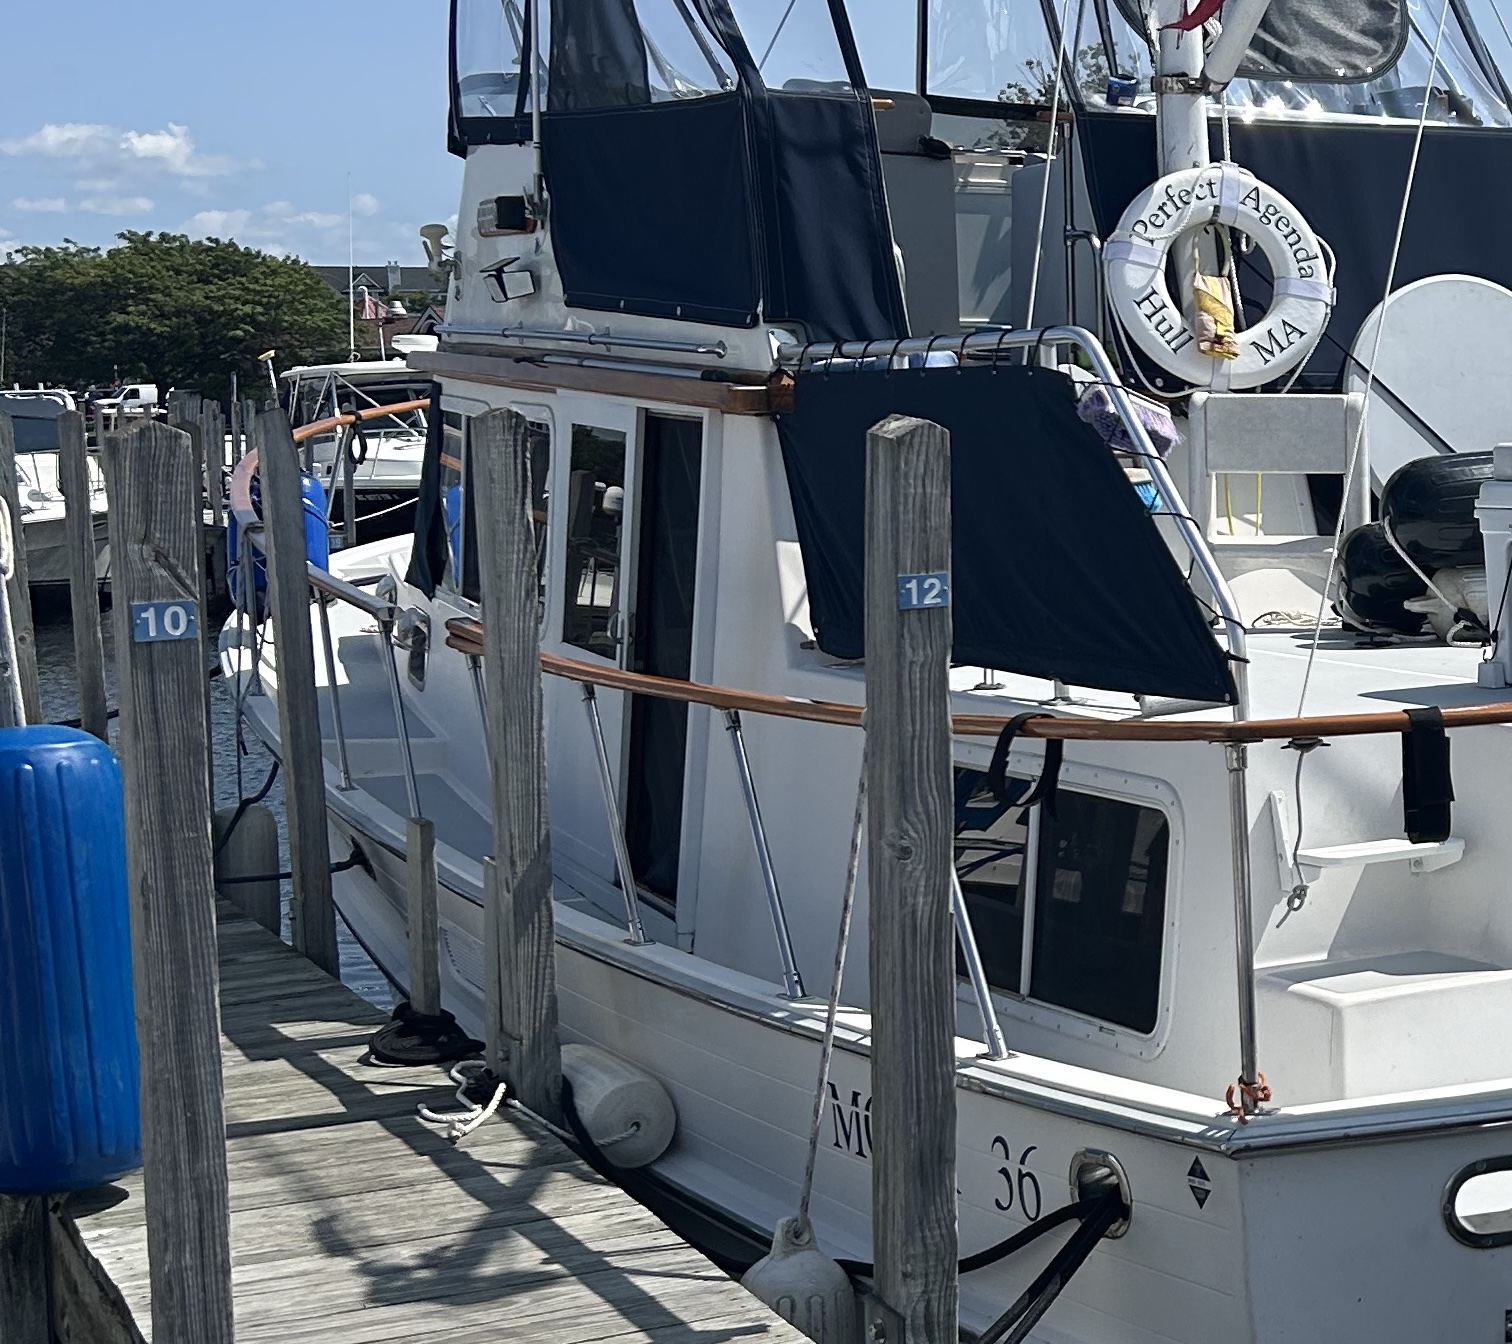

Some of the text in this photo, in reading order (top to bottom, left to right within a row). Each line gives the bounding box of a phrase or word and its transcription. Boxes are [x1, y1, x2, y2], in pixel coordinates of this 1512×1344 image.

[1130, 178, 1319, 279] Perfect Agenda
[1134, 286, 1307, 365] Hull MA
[141, 605, 187, 636] 10
[906, 578, 942, 604] 12
[991, 1135, 1041, 1221] 36
